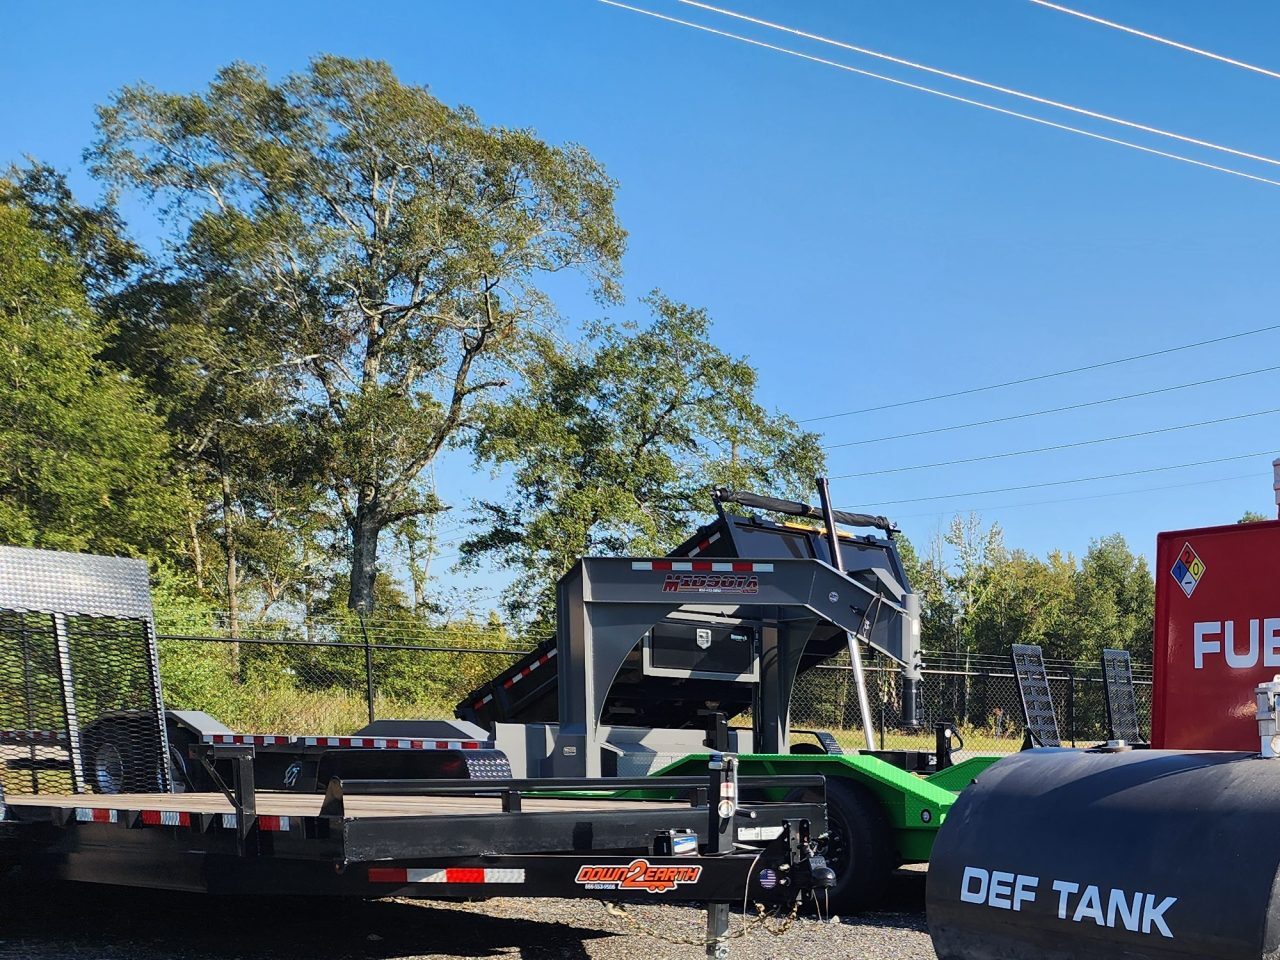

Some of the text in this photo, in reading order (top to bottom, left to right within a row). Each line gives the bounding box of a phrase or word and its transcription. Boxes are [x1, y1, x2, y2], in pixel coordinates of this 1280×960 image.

[1184, 551, 1192, 564] 2
[1192, 562, 1200, 576] 0
[960, 866, 1178, 938] DEF TANK
